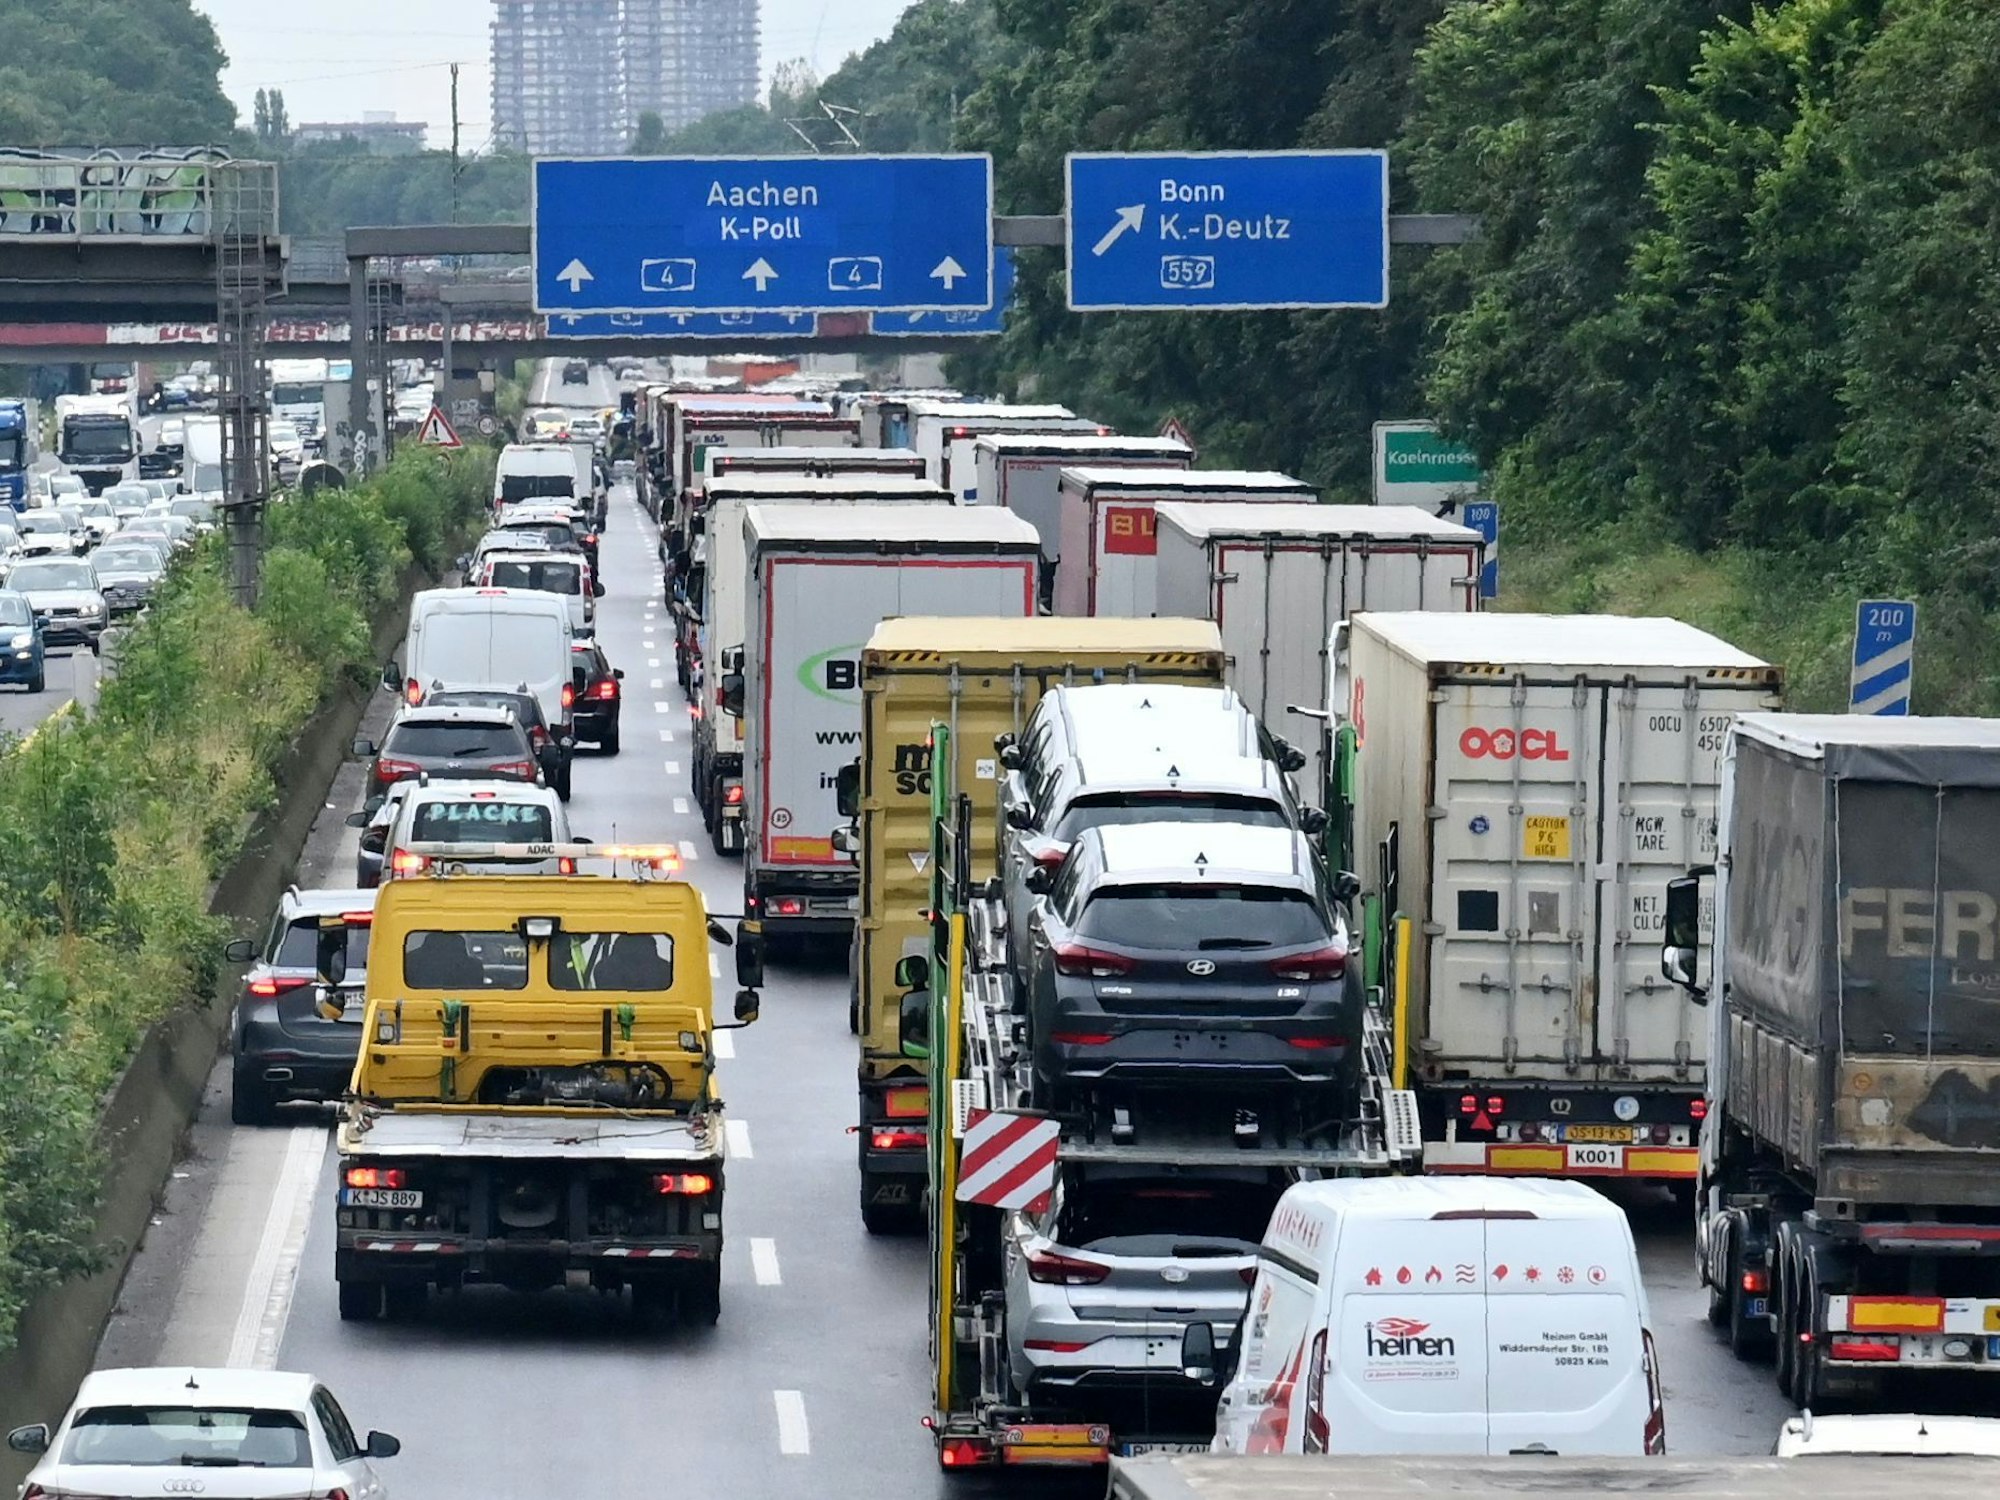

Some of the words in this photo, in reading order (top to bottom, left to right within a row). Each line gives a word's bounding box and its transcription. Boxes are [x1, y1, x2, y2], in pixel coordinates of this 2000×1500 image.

[706, 180, 818, 207] Aachen
[1160, 179, 1225, 202] Bonn
[720, 216, 802, 240] K-Poll
[1160, 213, 1290, 240] K.-Deutz
[661, 264, 674, 286] 4
[848, 264, 862, 285] 4
[1168, 261, 1207, 282] 559
[1471, 507, 1491, 521] 100
[1868, 608, 1904, 627] 200
[826, 660, 862, 690] B
[1526, 817, 1568, 829] CAUTION
[526, 844, 556, 855] ADAC
[1534, 844, 1557, 857] HIGH
[1840, 887, 2000, 962] FER
[391, 1191, 417, 1207] 889
[1367, 1327, 1455, 1357] heinen
[1579, 1331, 1608, 1341] GmbH
[1571, 1344, 1589, 1353] Str.
